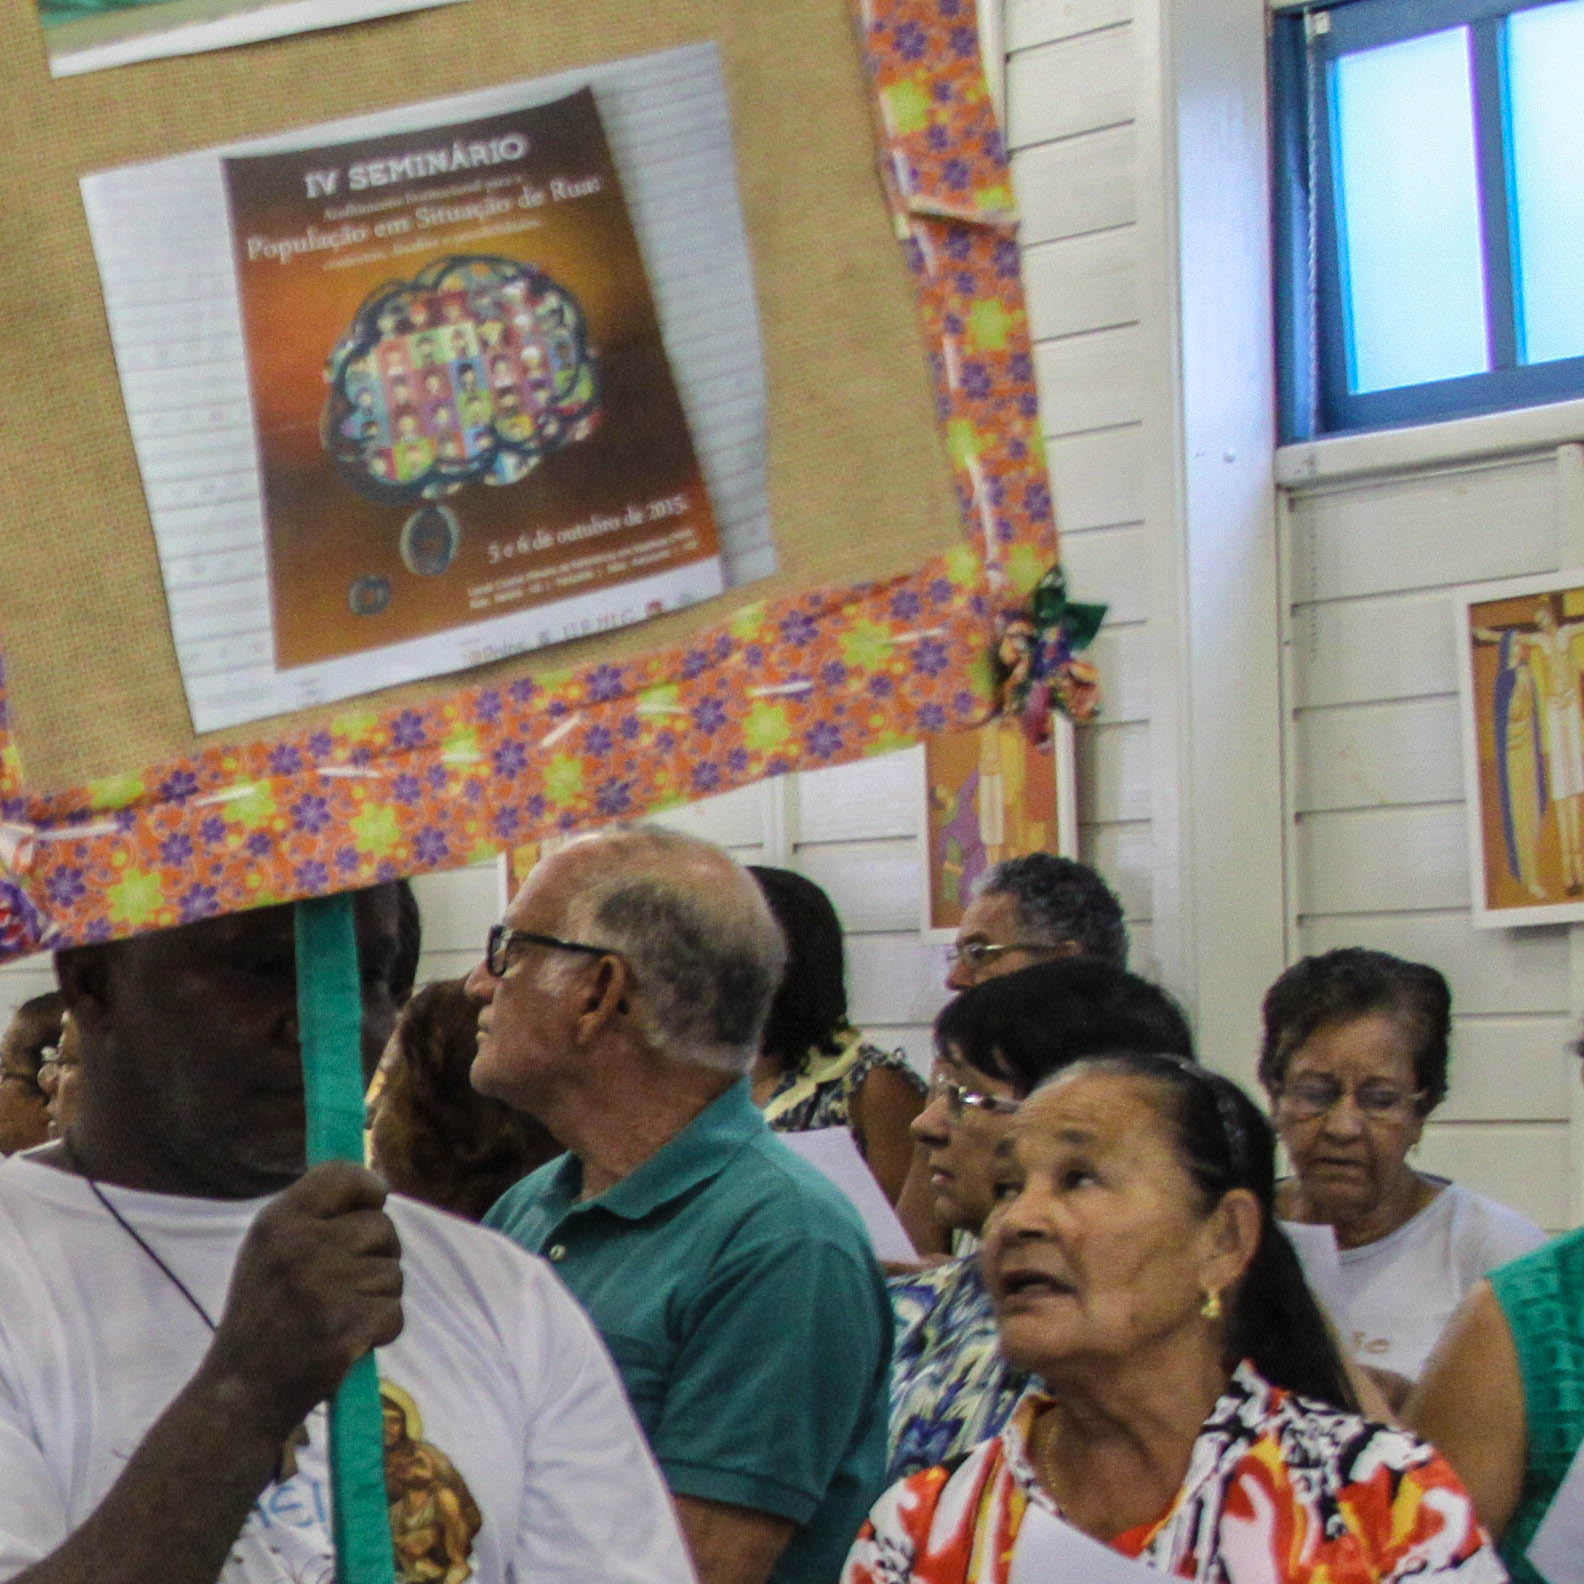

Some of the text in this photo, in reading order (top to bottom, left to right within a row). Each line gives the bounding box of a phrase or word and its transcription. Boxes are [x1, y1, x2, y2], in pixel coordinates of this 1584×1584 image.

[304, 132, 529, 199] IV SEMINÁRIO
[246, 217, 367, 264] População
[374, 217, 411, 239] em
[414, 192, 511, 227] Situação
[518, 183, 545, 209] de
